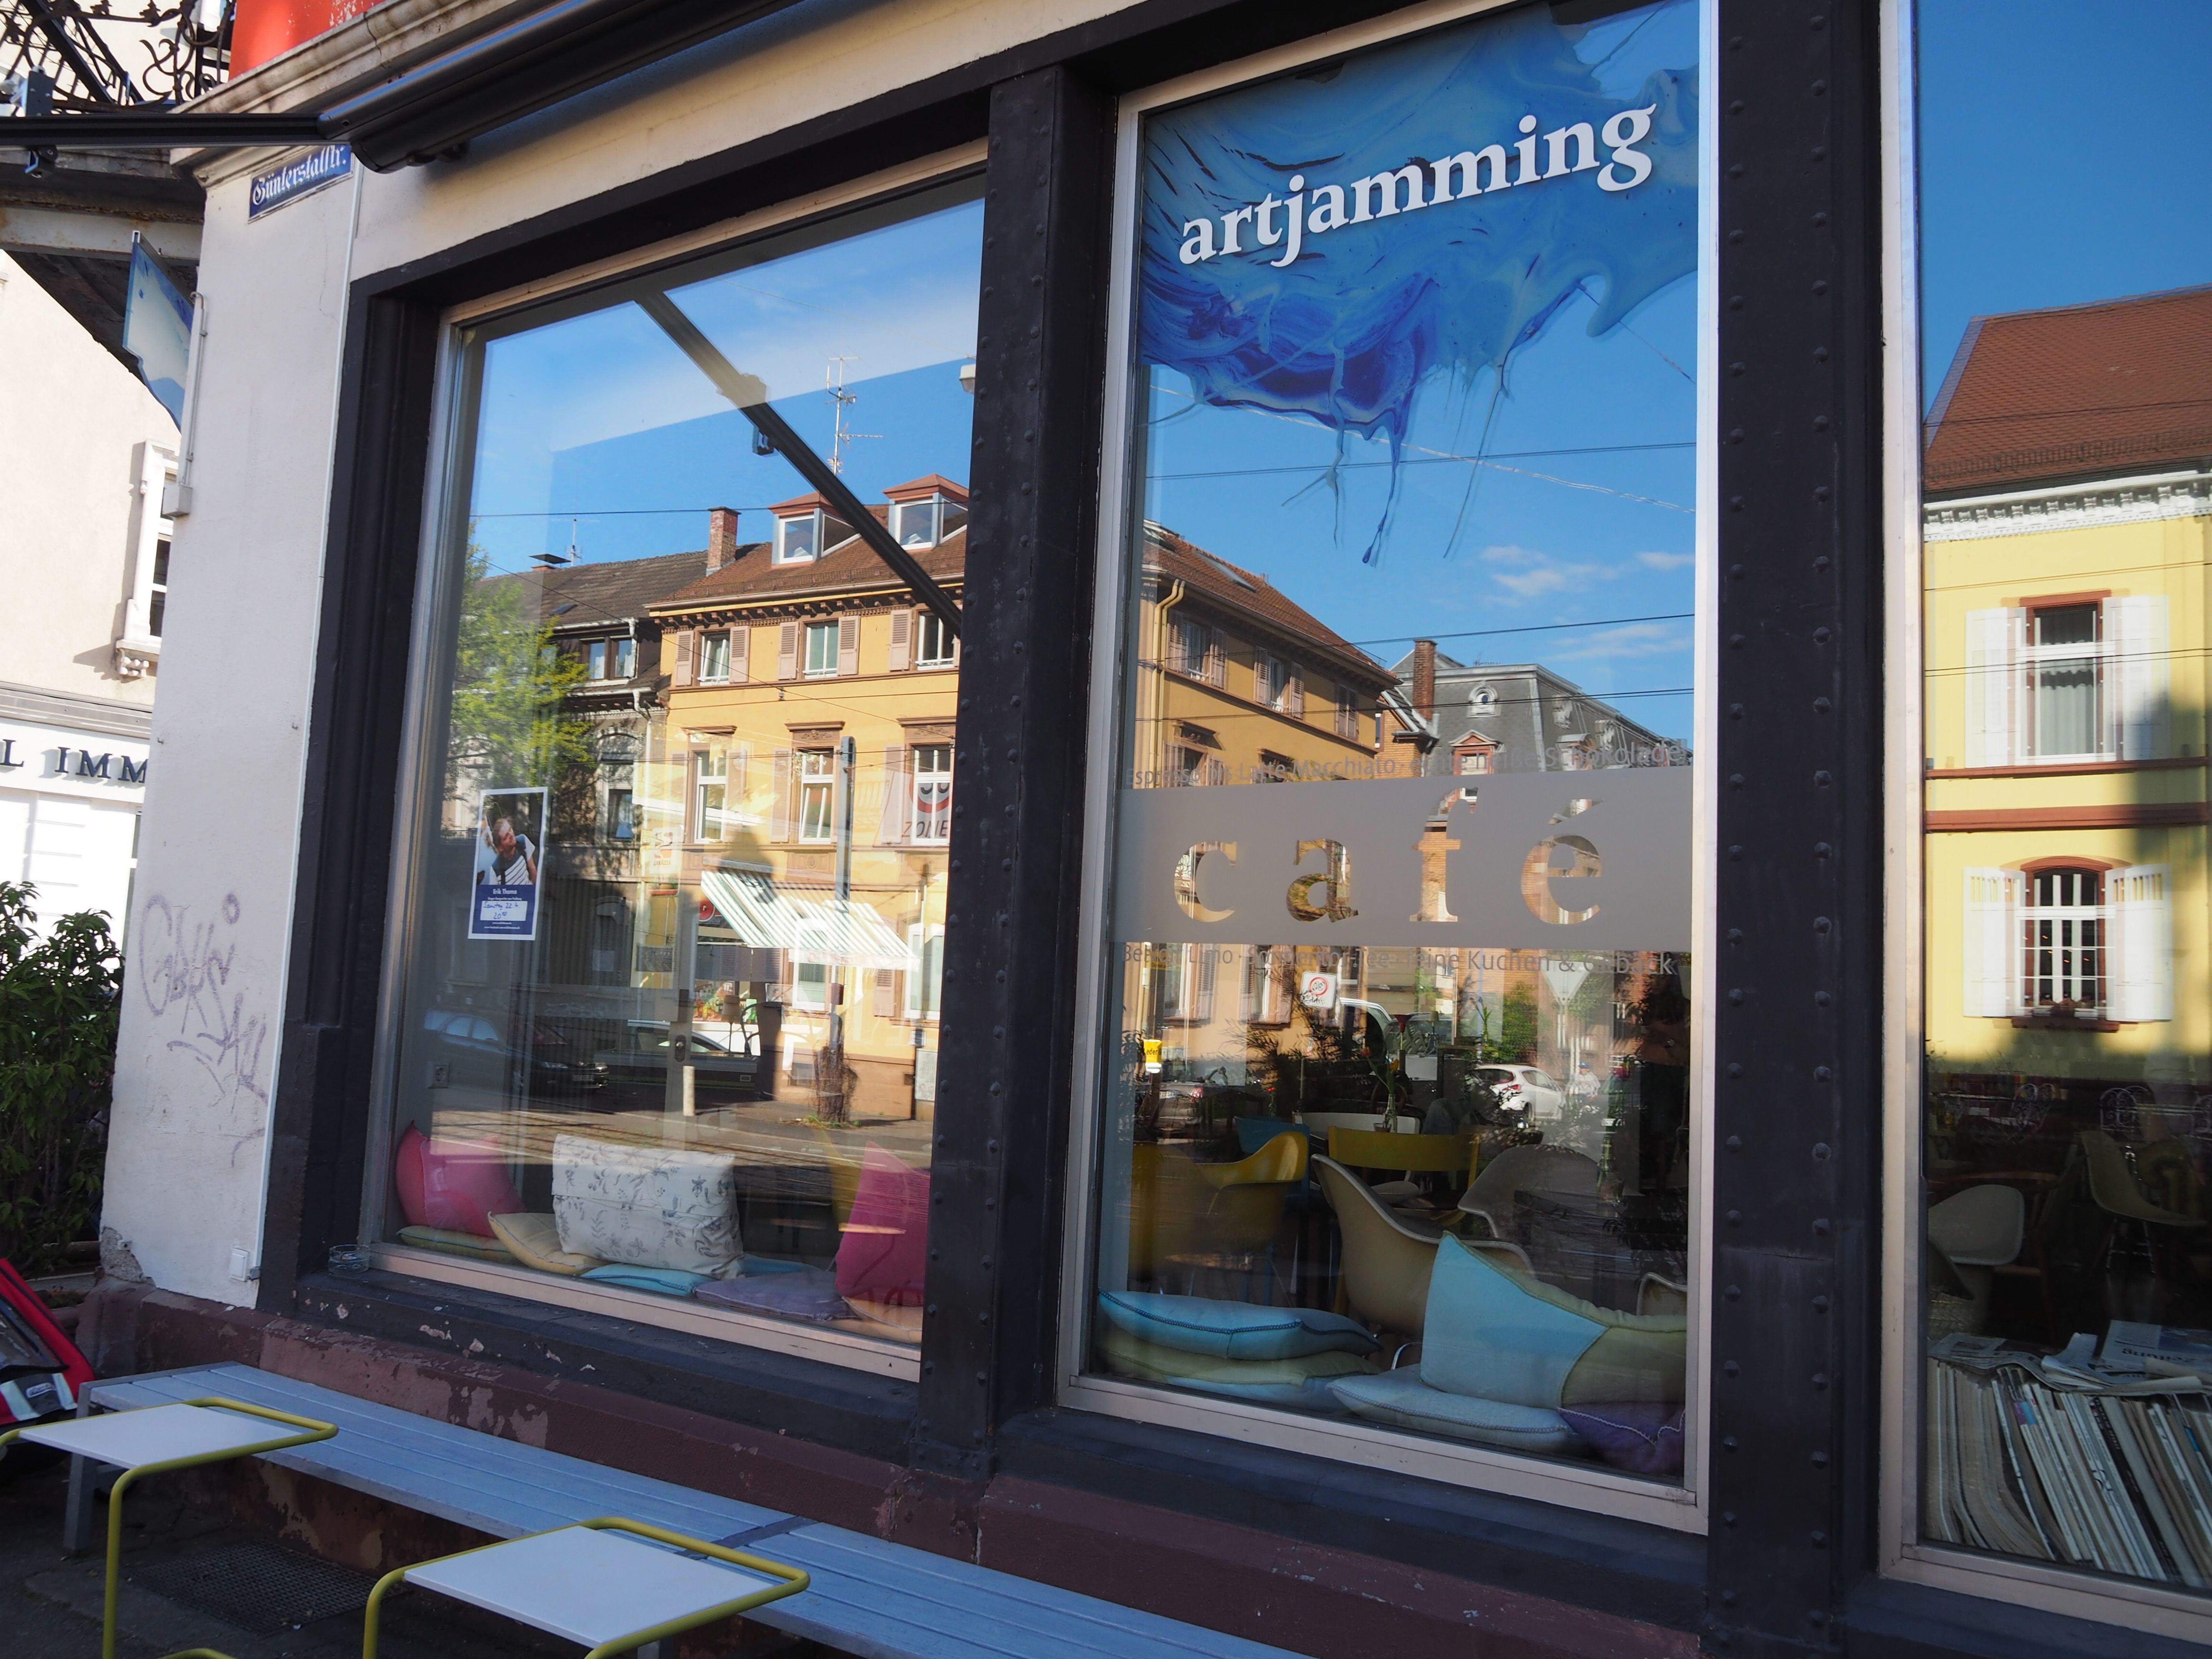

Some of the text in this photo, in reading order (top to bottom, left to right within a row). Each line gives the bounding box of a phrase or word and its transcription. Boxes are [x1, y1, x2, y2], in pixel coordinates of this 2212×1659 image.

[1179, 103, 1657, 268] artjamming
[1126, 768, 1200, 788] Espresso
[1240, 761, 1285, 780] Latte
[1294, 755, 1395, 777] Macchiato
[1545, 738, 1683, 767] Schokolade
[1174, 787, 1605, 925] café
[1407, 948, 1459, 969] feine
[1468, 949, 1549, 971] Kuchen
[1558, 952, 1575, 972] &
